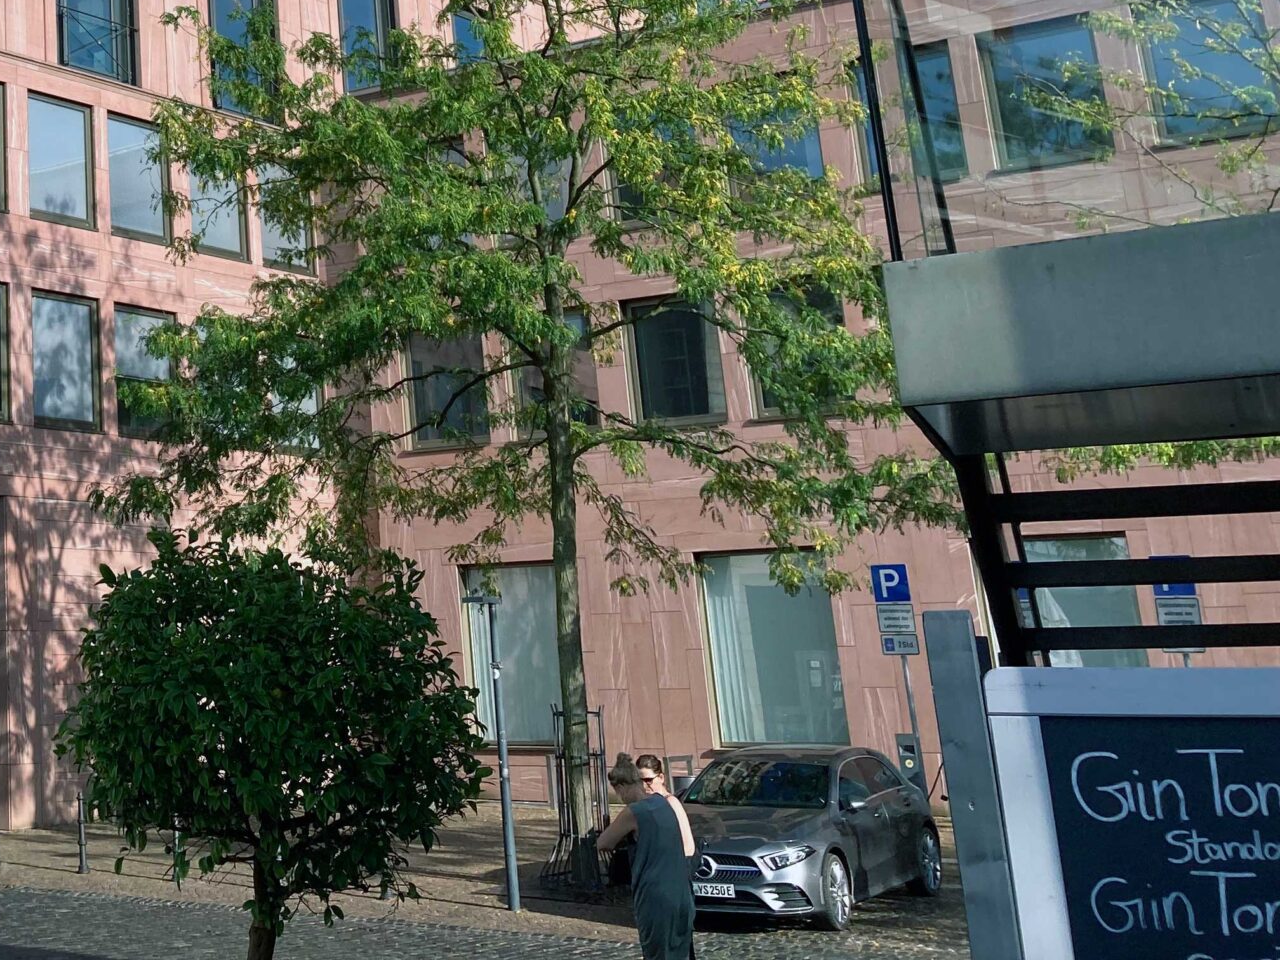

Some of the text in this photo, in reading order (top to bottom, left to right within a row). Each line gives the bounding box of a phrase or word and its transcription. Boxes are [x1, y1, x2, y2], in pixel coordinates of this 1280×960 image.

[879, 568, 900, 598] P
[1071, 751, 1190, 822] Gin
[1090, 877, 1204, 934] Gin
